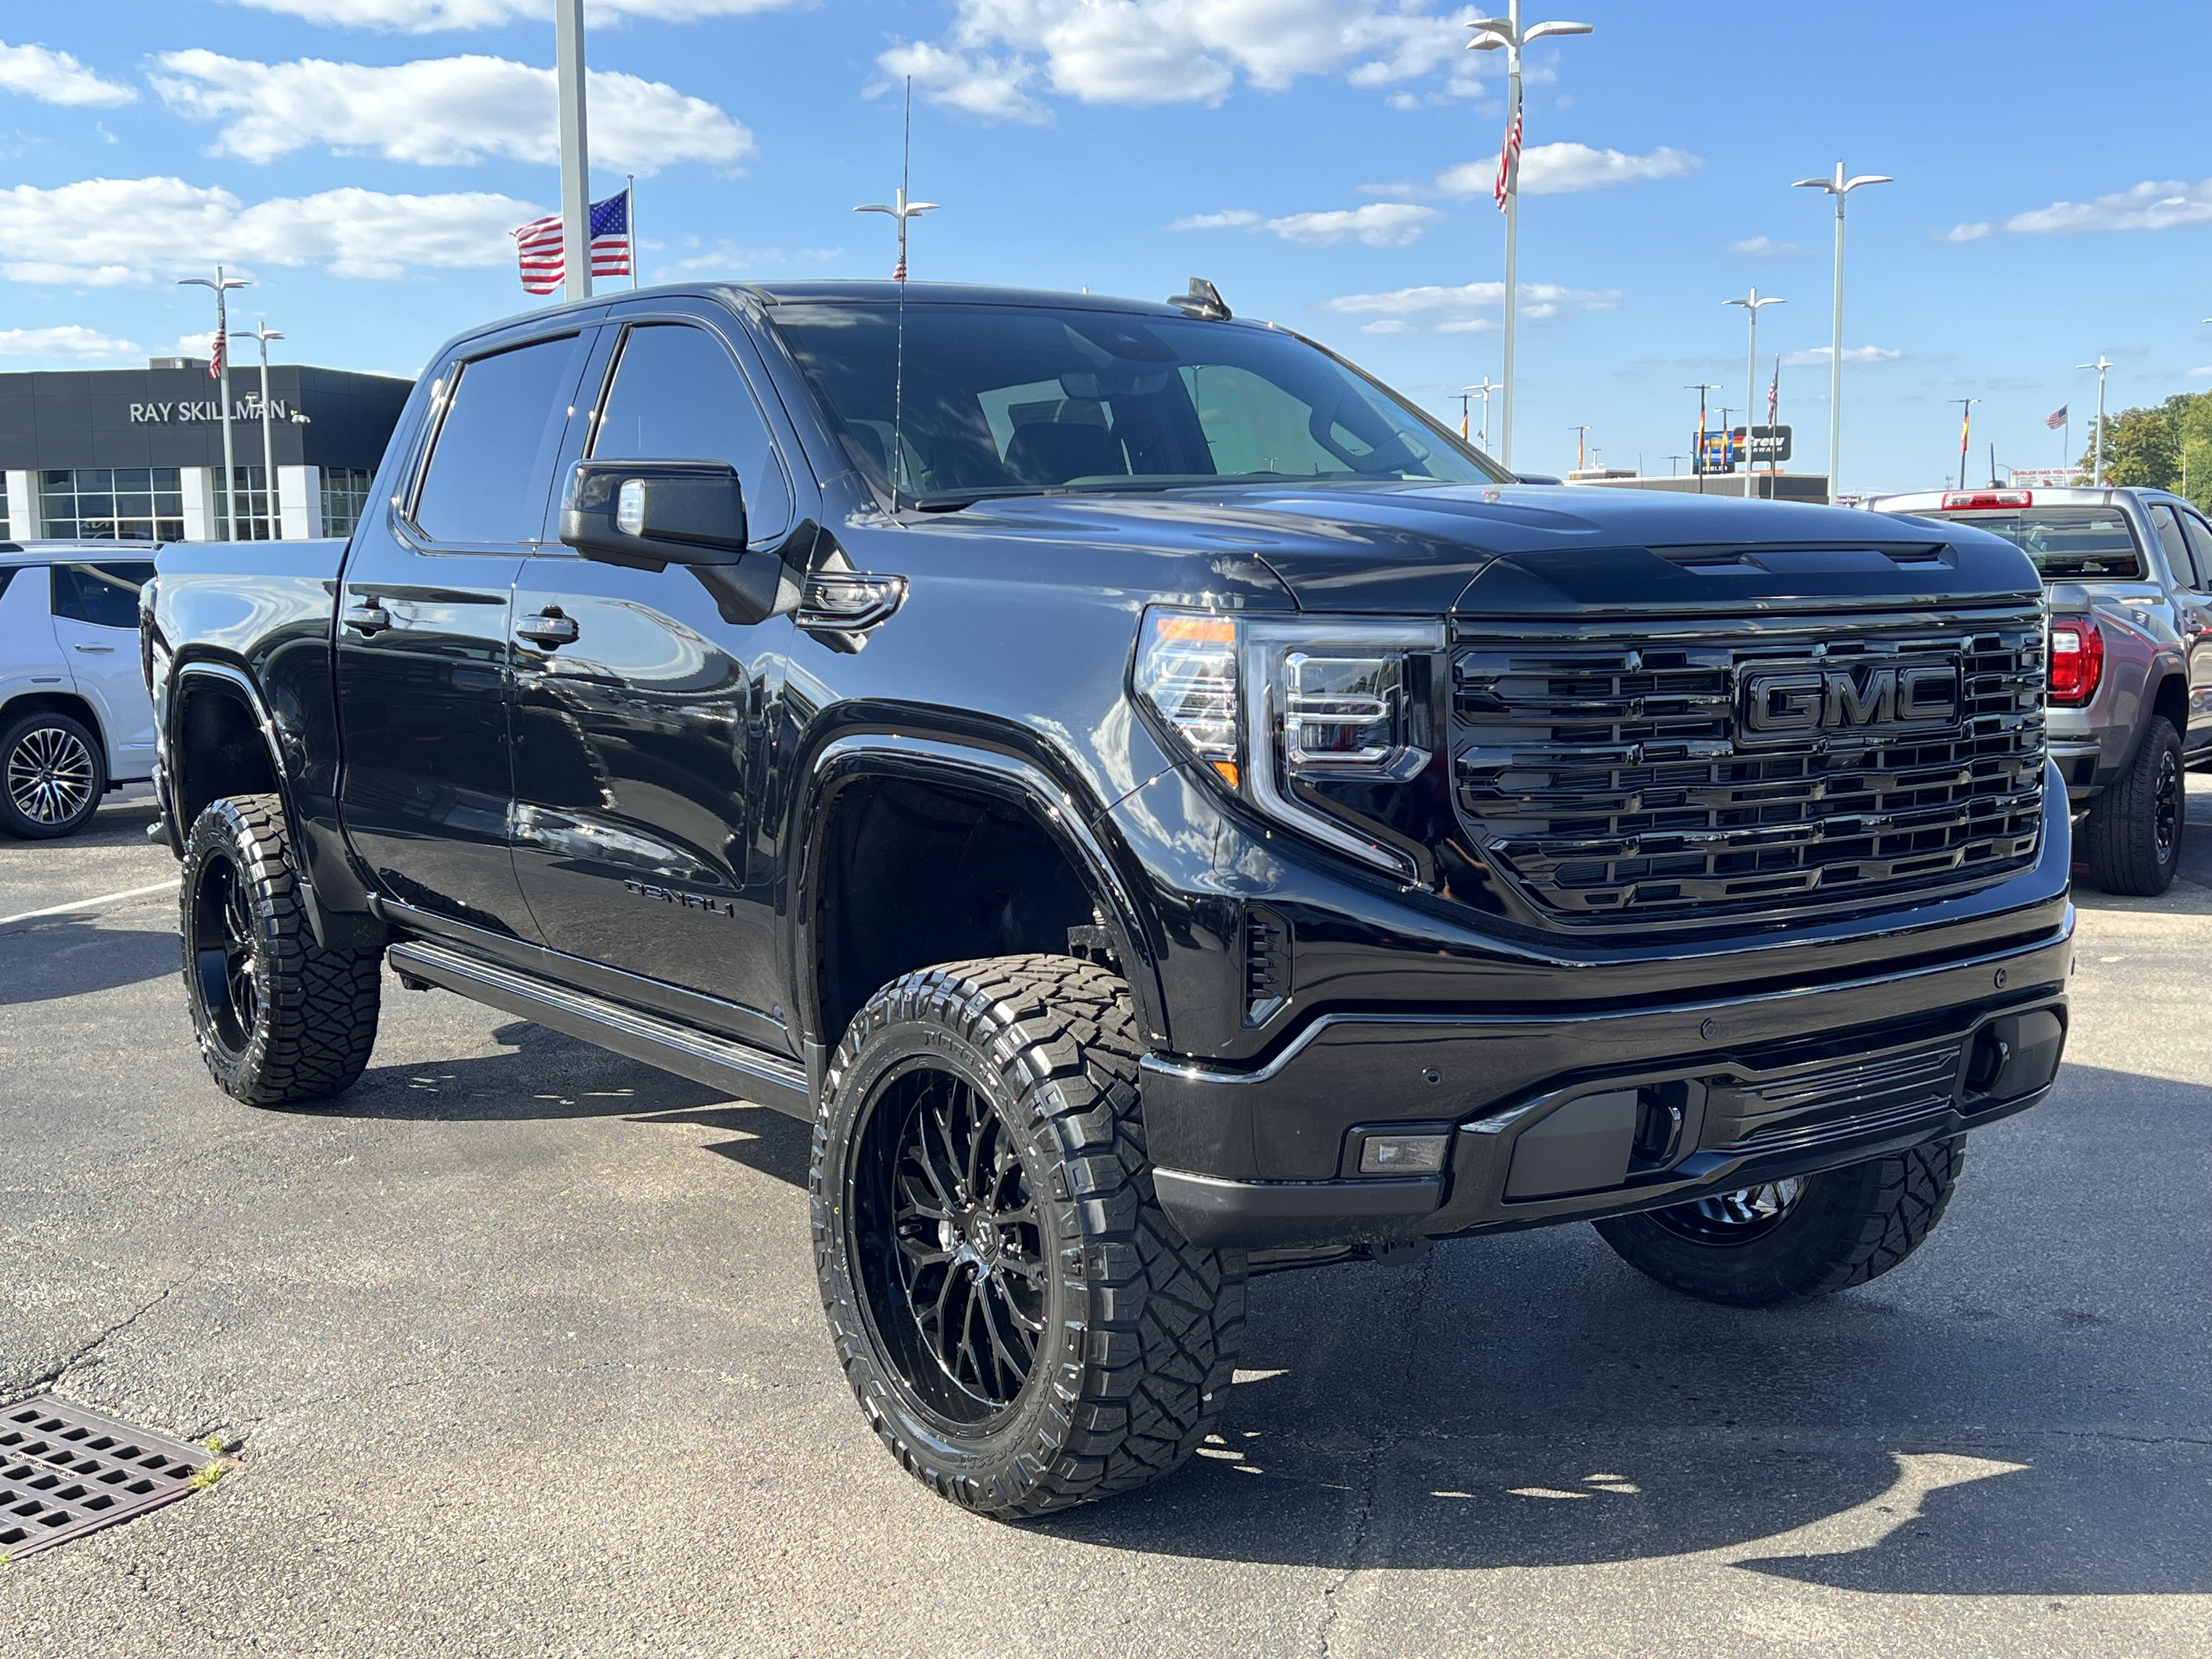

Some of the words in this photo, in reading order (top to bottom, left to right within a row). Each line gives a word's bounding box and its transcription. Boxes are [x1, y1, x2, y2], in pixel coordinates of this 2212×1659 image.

[130, 402, 174, 422] RAY
[1749, 665, 1956, 731] GMC
[623, 878, 735, 918] DENALI
